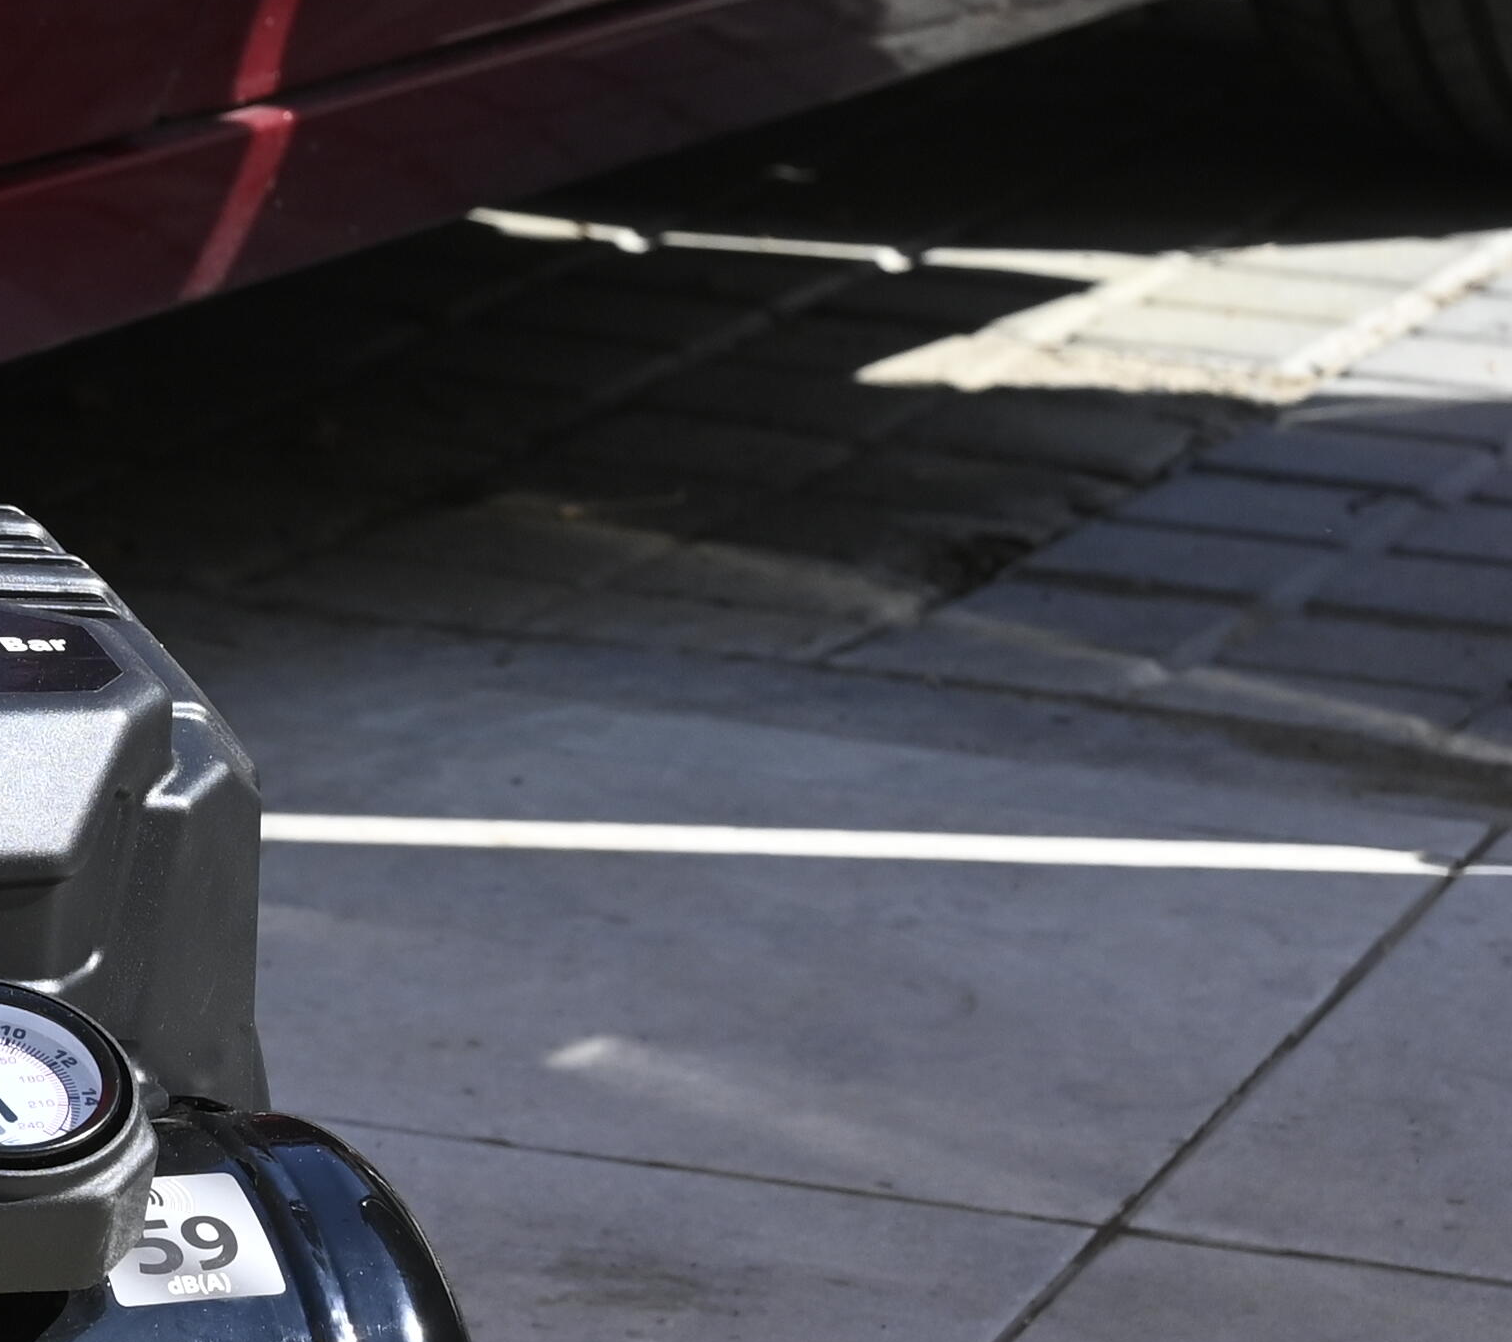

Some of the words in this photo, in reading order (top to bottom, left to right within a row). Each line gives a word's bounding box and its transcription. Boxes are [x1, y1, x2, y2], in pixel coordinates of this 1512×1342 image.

[0, 1024, 27, 1040] 10
[55, 1049, 78, 1068] 12
[81, 1087, 99, 1107] 14
[133, 1215, 239, 1275] 59
[167, 1273, 232, 1296] dB(A)
